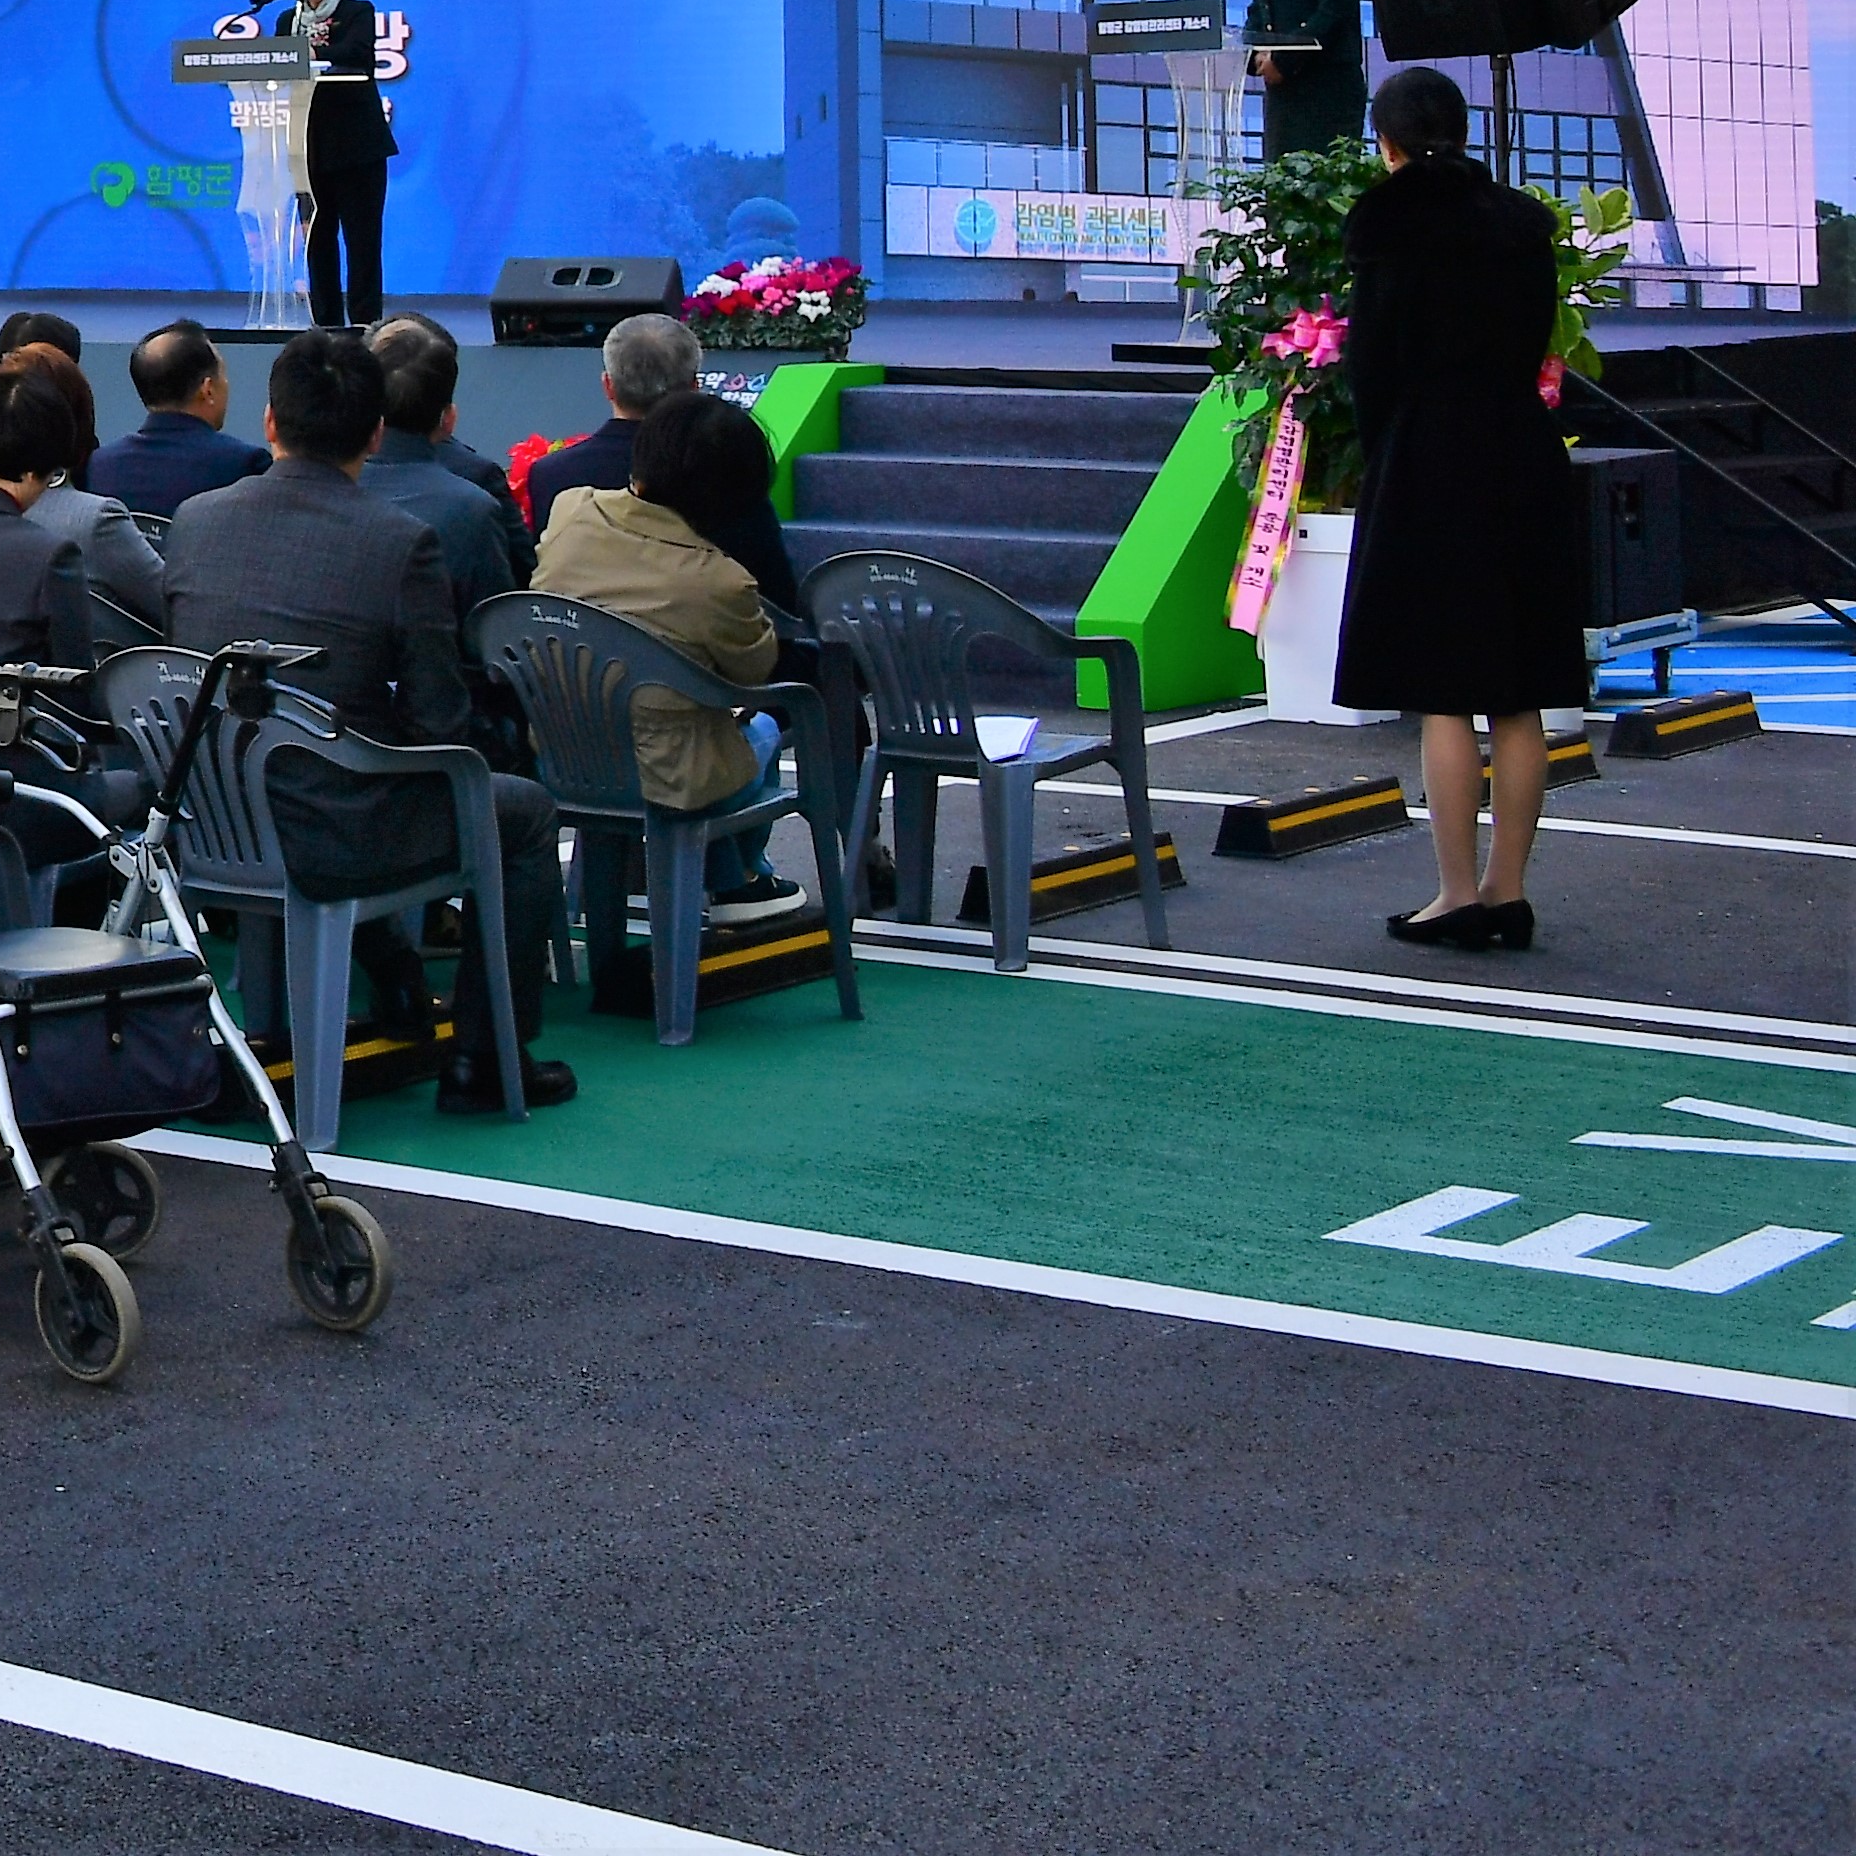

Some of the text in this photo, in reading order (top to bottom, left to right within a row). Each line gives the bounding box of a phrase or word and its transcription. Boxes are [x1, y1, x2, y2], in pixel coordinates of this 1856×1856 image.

[147, 164, 232, 196] 함평군
[1018, 203, 1167, 232] 감염병 관리센터
